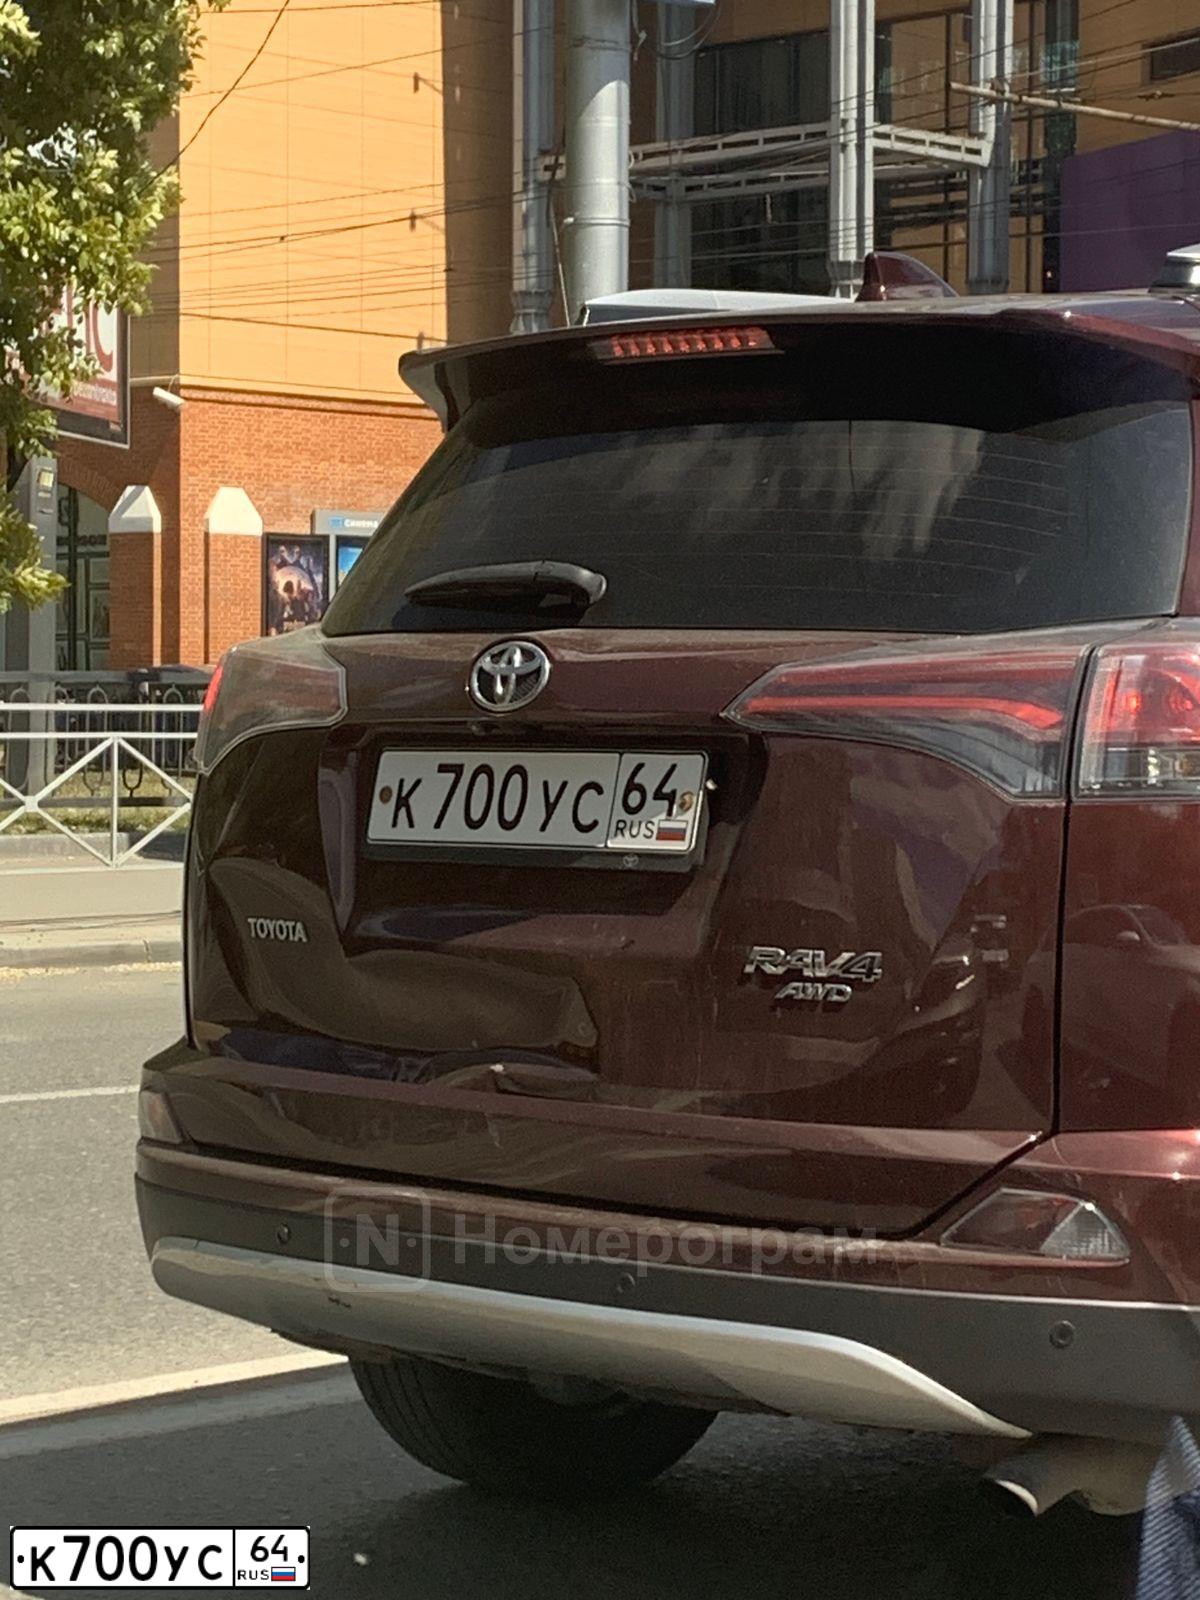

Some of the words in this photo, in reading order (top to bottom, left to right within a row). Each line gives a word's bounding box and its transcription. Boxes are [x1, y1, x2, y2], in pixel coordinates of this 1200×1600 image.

[621, 762, 678, 817] 64
[613, 819, 655, 839] RUS
[247, 917, 307, 942] TOYOTA
[743, 946, 882, 982] RAV4
[774, 981, 852, 1002] AWD
